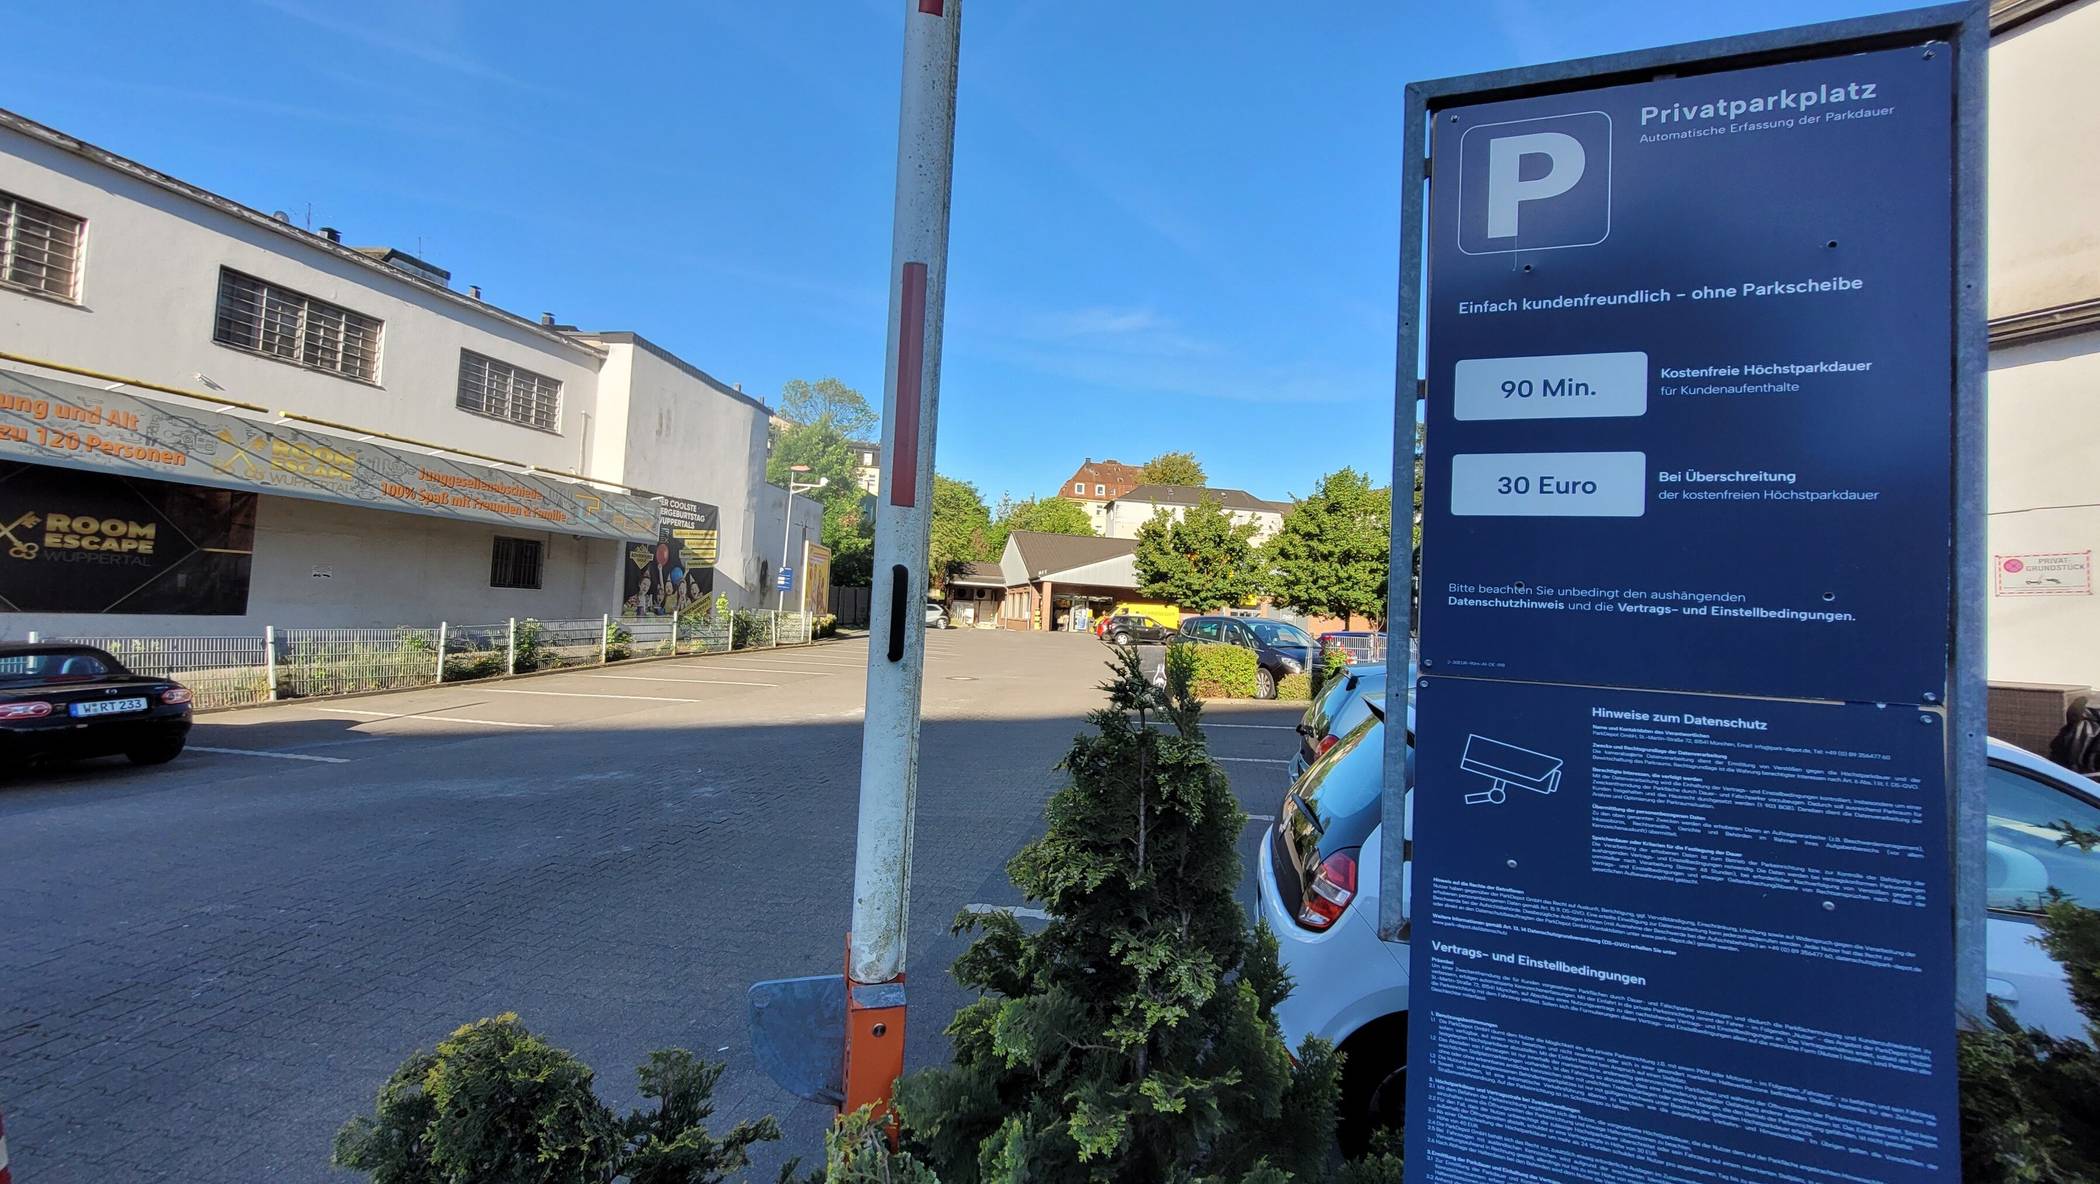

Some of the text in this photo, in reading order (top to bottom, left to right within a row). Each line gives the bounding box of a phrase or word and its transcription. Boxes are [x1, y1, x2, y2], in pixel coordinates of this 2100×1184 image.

[1641, 82, 1878, 126] Privatparkplatz
[1640, 107, 1894, 143] Automatische Erfassung der Parkdauer
[1488, 133, 1585, 238] P
[1459, 299, 1517, 313] Einfach
[1523, 289, 1670, 310] kundenfreundlich
[1692, 286, 1736, 299] ohne
[1744, 277, 1863, 296] Parkscheibe
[1662, 361, 1872, 378] Kostenfreie Höchstparkdauer
[1501, 378, 1595, 398] 90 Min.
[1660, 382, 1799, 396] für Kundenaufenthalte
[55, 403, 100, 425] und
[108, 411, 140, 431] Alt
[36, 427, 80, 451] 120
[86, 434, 187, 466] Personen
[271, 438, 357, 468] ROOM
[418, 464, 544, 500] Junggesellenabschiede
[1498, 476, 1596, 494] 30 Euro
[1659, 469, 1796, 484] Bei Überschreitung
[380, 480, 416, 500] 100%
[419, 489, 448, 506] Spaß
[451, 494, 471, 508] mit
[474, 497, 521, 516] Freunden
[532, 509, 567, 522] Familie
[669, 500, 697, 512] COOLSTE
[1659, 490, 1879, 501] der kostenfreien Höchstparkdauer
[45, 512, 157, 541] ROOM
[44, 533, 155, 555] ESCAPE
[44, 550, 152, 567] WUPPERTAL
[1449, 583, 1745, 602] Bitte beachten Sie unbedingt den aushängenden
[1449, 597, 1564, 609] Datenschutzhinweis
[1569, 602, 1591, 610] und
[1595, 602, 1613, 611] die
[1683, 606, 1707, 615] und
[1711, 606, 1857, 623] Einstellbedingungen.
[100, 702, 117, 712] RT
[119, 700, 142, 710] 233
[1593, 707, 1767, 730] Hinweise zum Datenschutz
[1492, 953, 1514, 963] und
[1517, 955, 1647, 986] Einstellbedingungen
